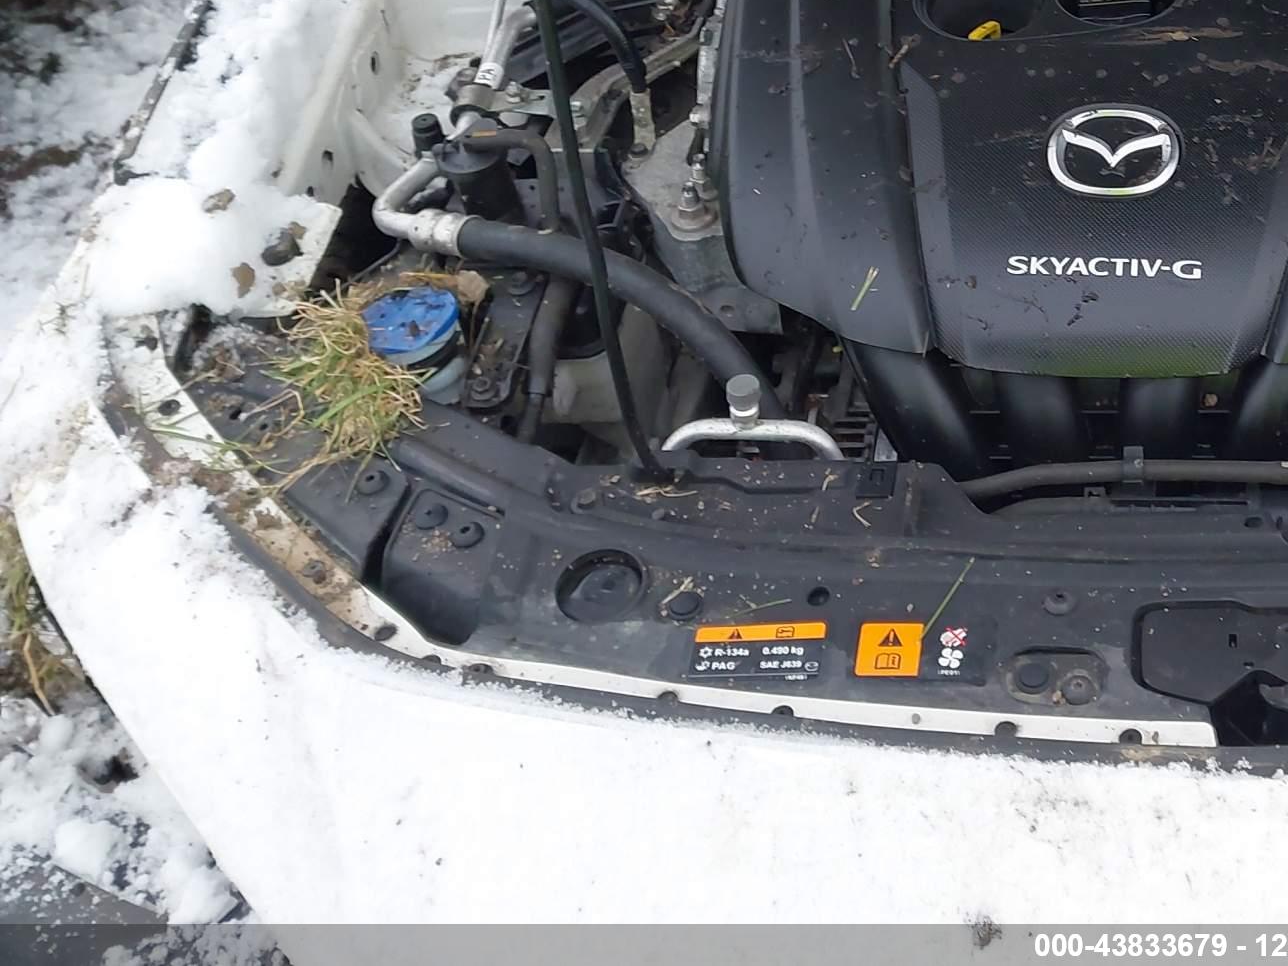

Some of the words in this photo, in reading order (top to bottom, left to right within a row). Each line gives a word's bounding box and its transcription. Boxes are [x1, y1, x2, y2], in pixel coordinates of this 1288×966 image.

[1006, 256, 1202, 280] SKYACTIV-G
[714, 647, 750, 657] R-134a
[790, 645, 804, 656] kg
[711, 661, 736, 671] PAG
[759, 660, 780, 669] SAE
